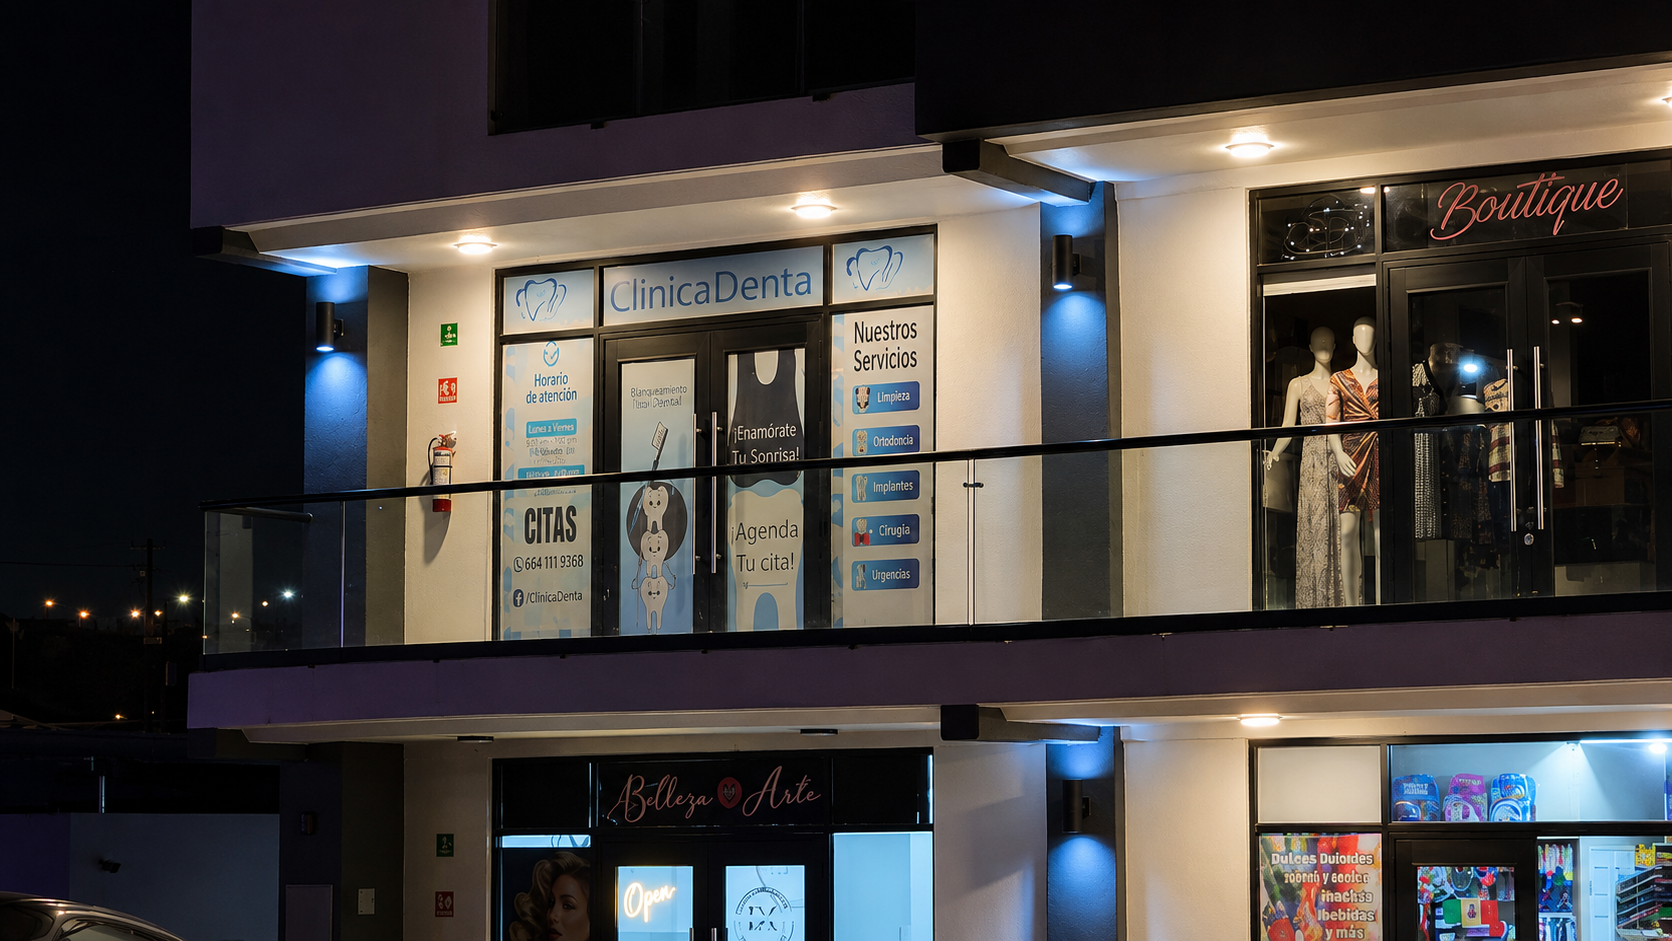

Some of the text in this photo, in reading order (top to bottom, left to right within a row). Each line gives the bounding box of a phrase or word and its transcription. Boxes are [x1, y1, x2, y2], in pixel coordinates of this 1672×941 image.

[1429, 172, 1624, 241] Boutique
[610, 267, 812, 313] ClinicaDenta
[854, 320, 917, 344] Nuestros
[853, 347, 917, 372] Servicios
[534, 372, 568, 387] Horario
[526, 387, 577, 404] de atención
[877, 390, 910, 405] Limpieza
[733, 423, 797, 444] ¡Enamórate
[873, 434, 913, 447] Ortodoncia
[732, 447, 800, 465] Tu Sonrisa!
[873, 480, 914, 495] Implantes
[524, 505, 577, 544] CITAS
[731, 519, 799, 546] ¡Agenda
[525, 554, 584, 570] 664 111 9368
[736, 552, 794, 572] Tu cita!
[872, 568, 911, 583] Urgencias
[525, 590, 583, 605] /ClinicaDenta
[607, 766, 821, 823] Belleza Arte
[1271, 852, 1317, 865] Dulces
[624, 882, 677, 923] Open
[1325, 924, 1364, 940] y más
